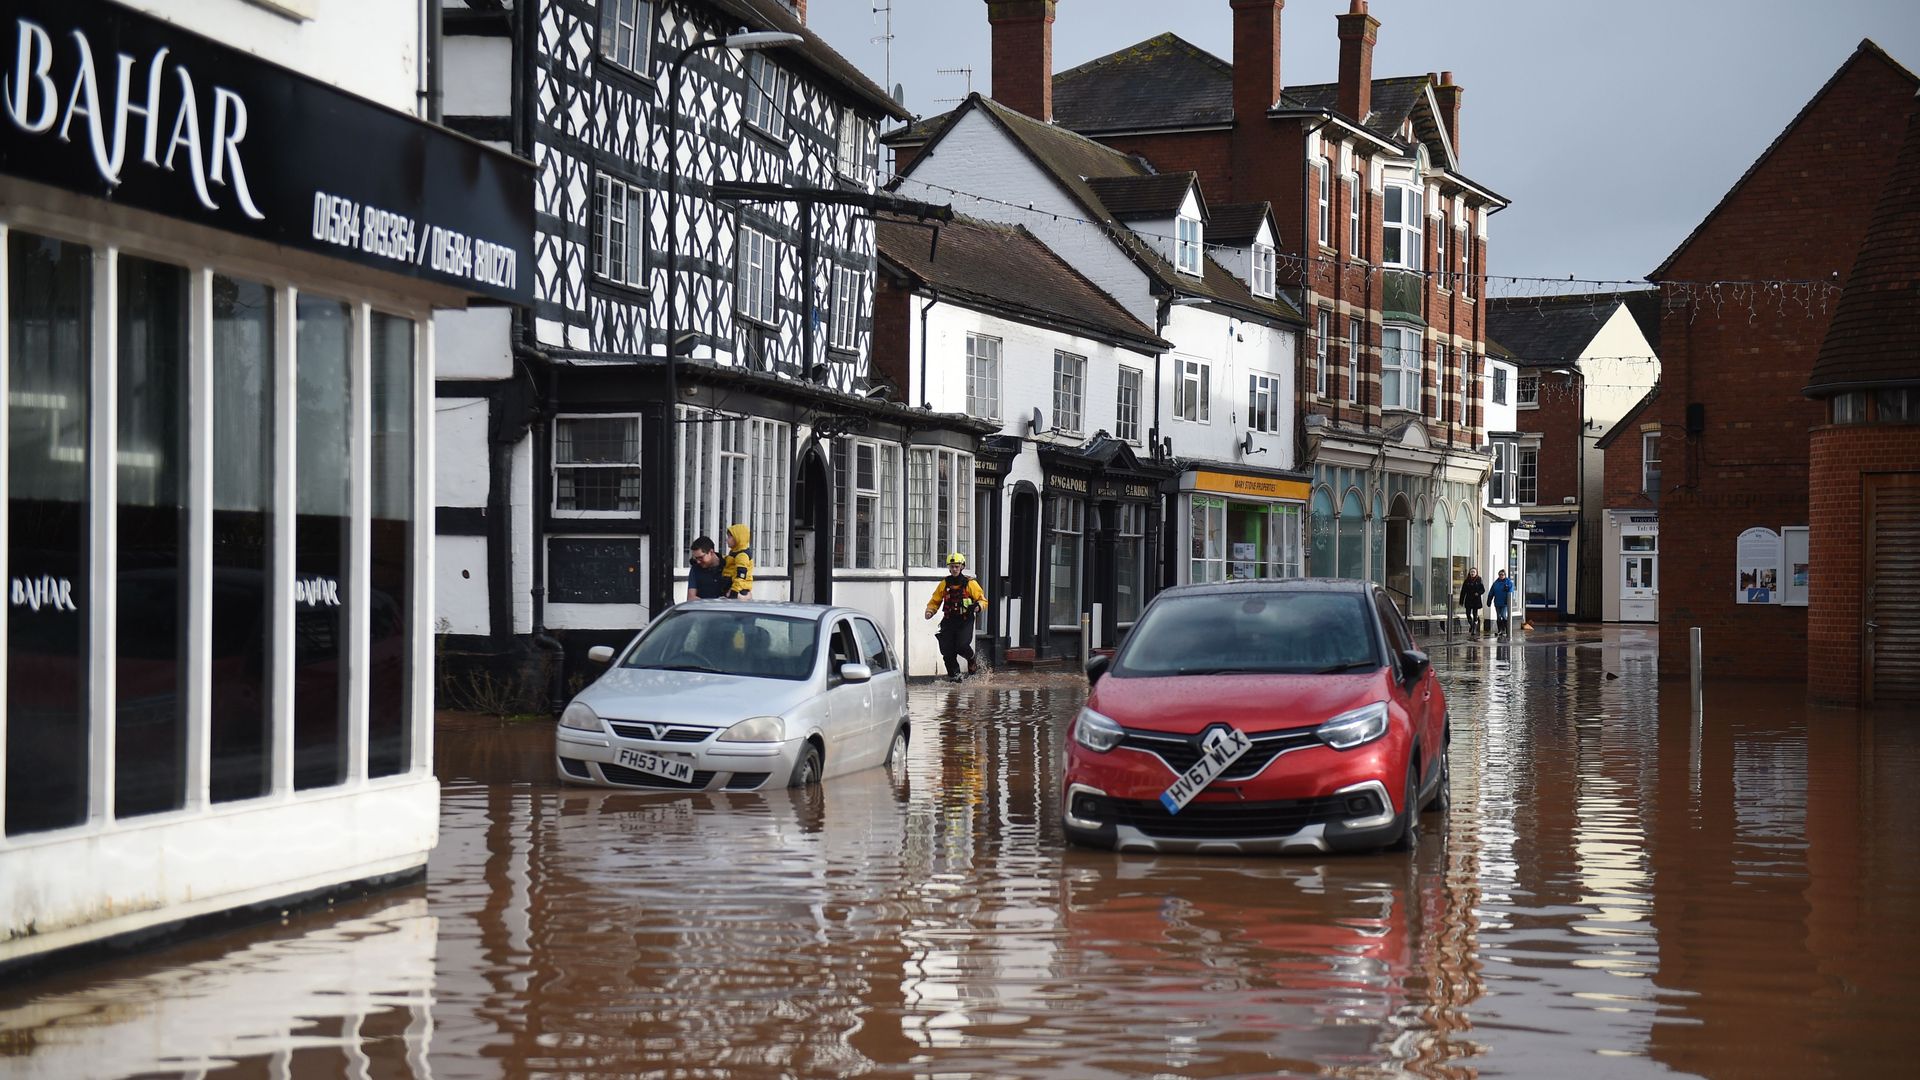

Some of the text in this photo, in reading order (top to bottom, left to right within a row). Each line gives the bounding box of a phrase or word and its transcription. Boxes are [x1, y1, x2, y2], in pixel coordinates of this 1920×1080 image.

[4, 19, 265, 219] BAHAR
[312, 191, 516, 290] 01584 819364 / 01584 810271
[1050, 474, 1087, 493] SINGAPORE
[1125, 484, 1149, 497] GARDEN
[11, 576, 77, 611] BAHAR
[295, 577, 341, 606] BAHAR
[619, 750, 689, 779] FH53 YJM
[1170, 732, 1246, 803] HV67 WLX
